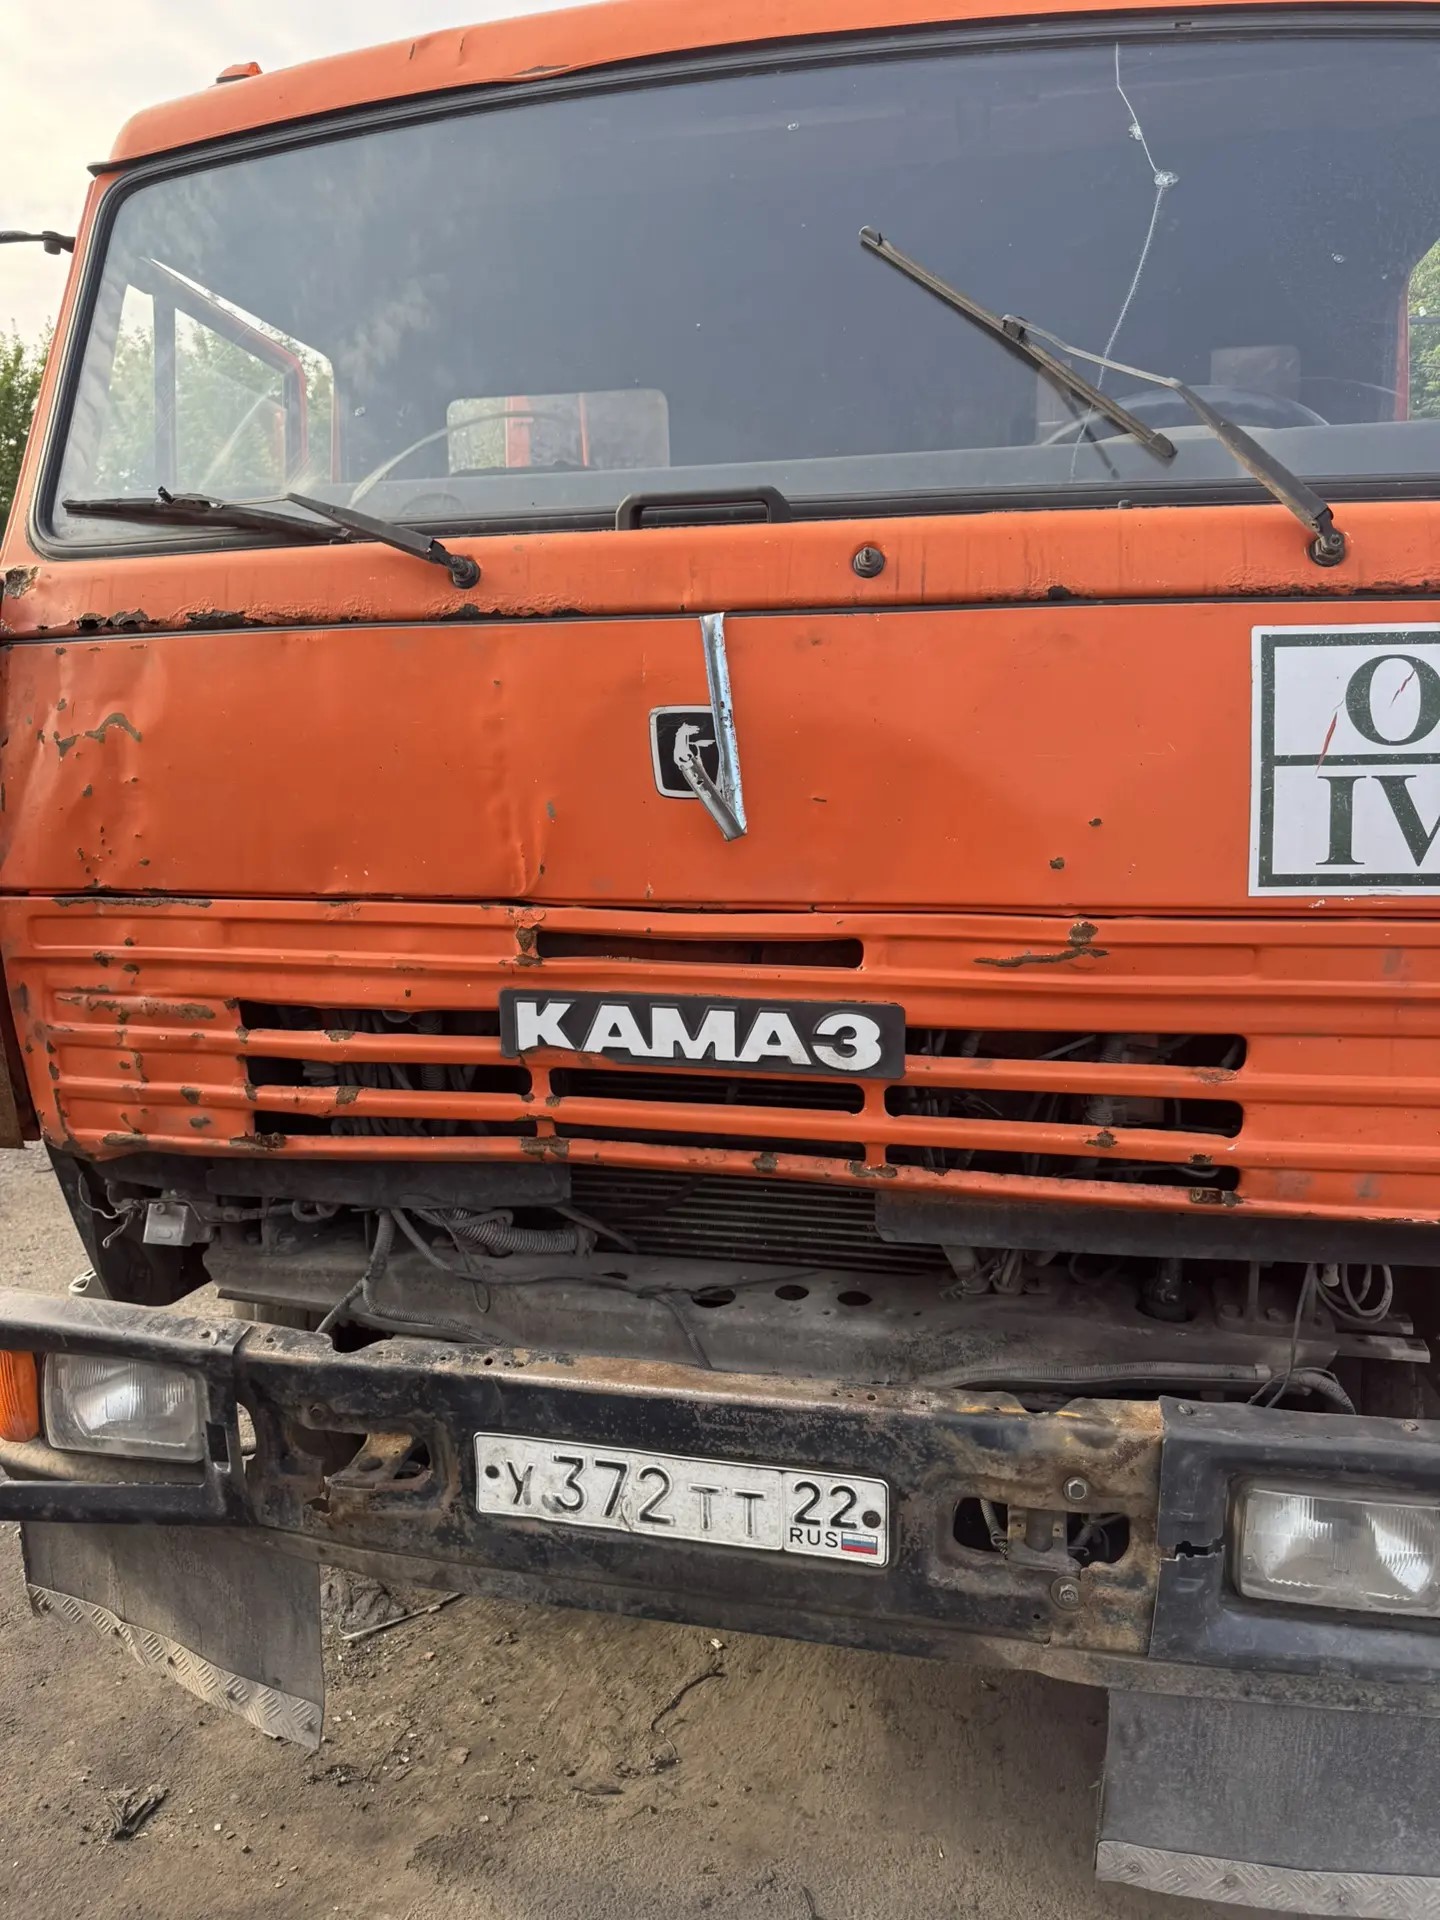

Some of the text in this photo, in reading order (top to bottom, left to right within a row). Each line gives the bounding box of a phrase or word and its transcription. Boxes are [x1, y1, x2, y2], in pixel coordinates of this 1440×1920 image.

[1315, 774, 1440, 867] IV
[517, 1001, 881, 1071] КАМАЗ
[793, 1480, 859, 1529] 22
[789, 1528, 839, 1549] RUS
